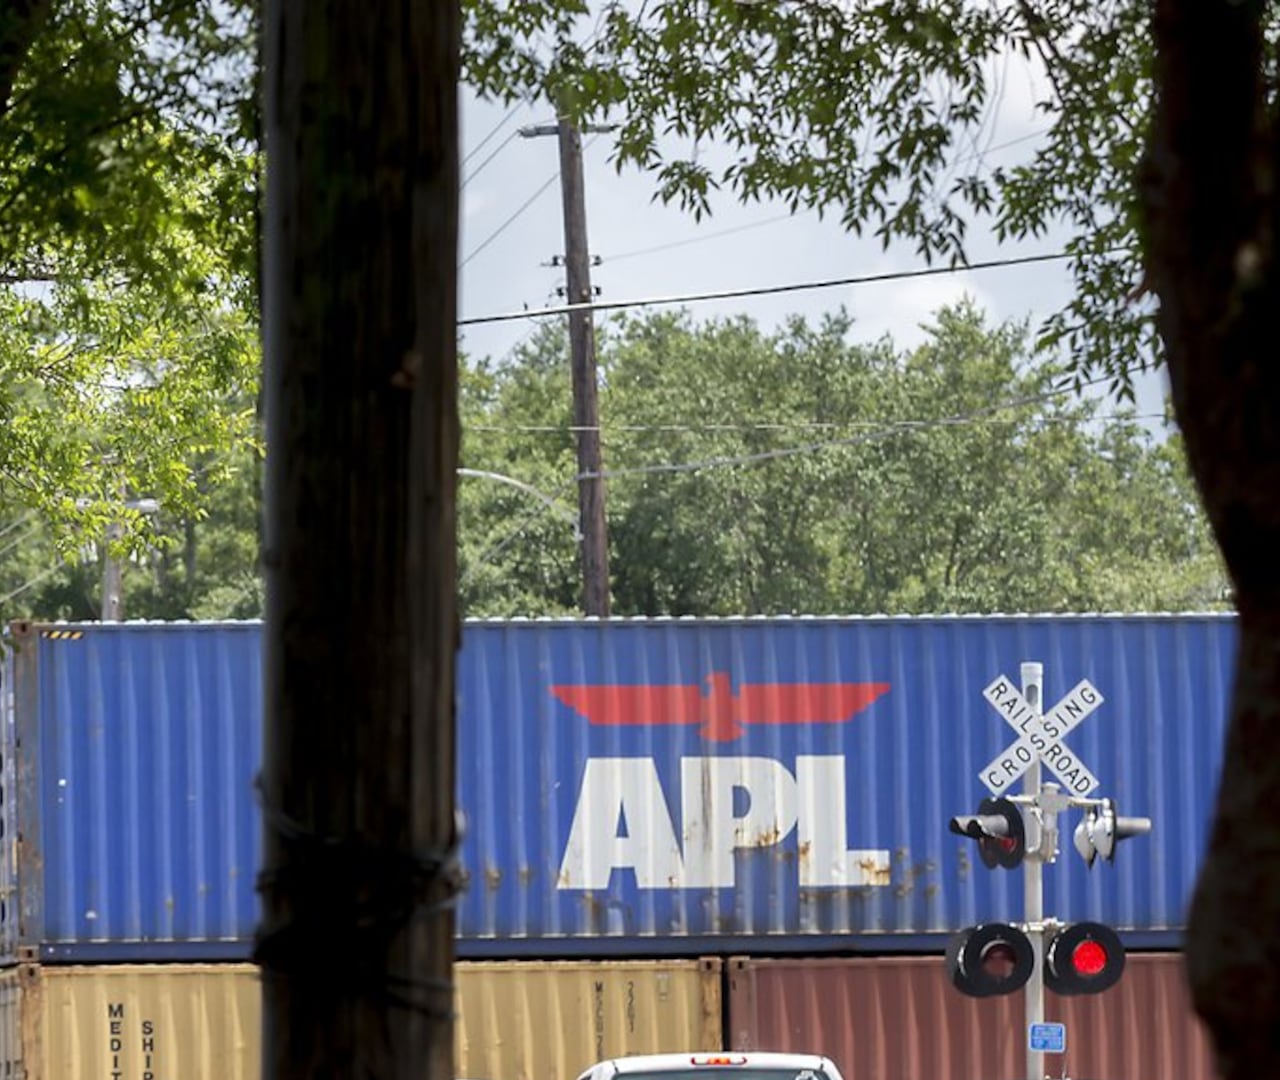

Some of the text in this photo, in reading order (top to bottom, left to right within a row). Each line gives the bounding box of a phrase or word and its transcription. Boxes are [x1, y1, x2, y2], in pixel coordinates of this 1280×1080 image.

[988, 688, 1096, 788] CROSSING
[990, 682, 1091, 793] RAILROAD
[557, 755, 890, 889] APL
